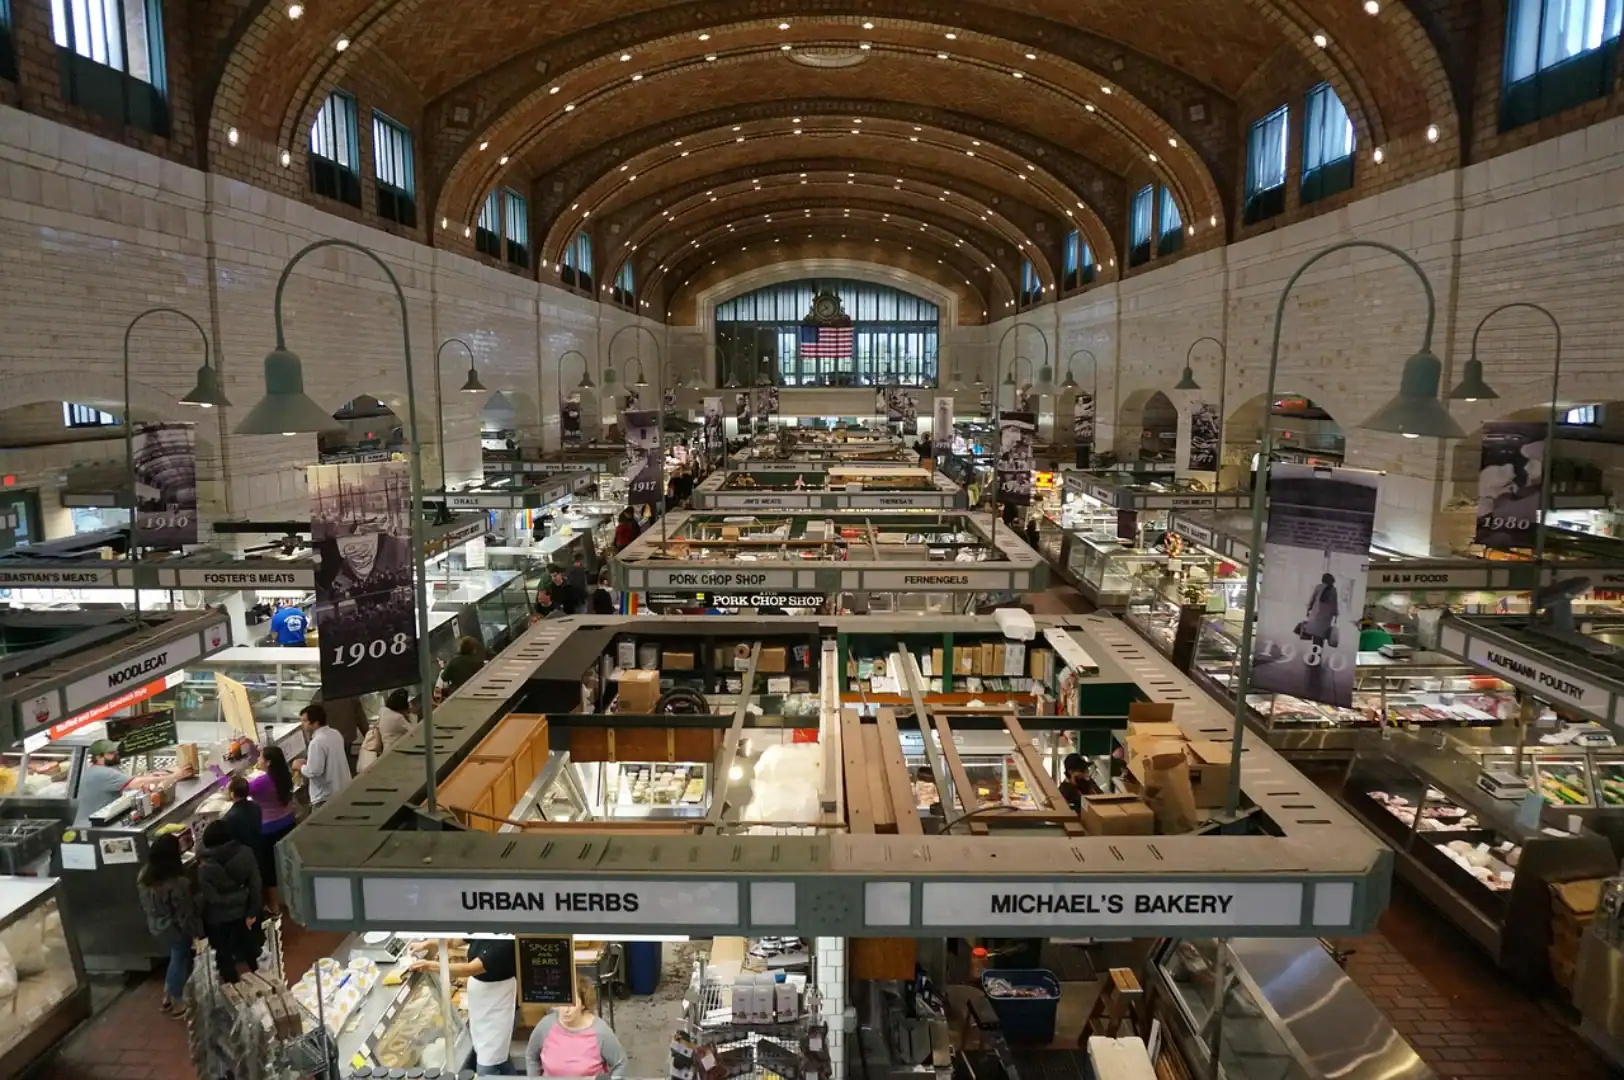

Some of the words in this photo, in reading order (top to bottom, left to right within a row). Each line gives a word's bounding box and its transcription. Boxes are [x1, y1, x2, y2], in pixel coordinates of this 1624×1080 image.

[633, 480, 657, 492] 1917
[146, 516, 189, 531] 1910
[1482, 515, 1530, 530] 1980
[61, 573, 98, 583] MEATS
[204, 573, 257, 583] FOSTER'S
[260, 573, 296, 583] MEATS
[669, 574, 698, 585] PORK
[701, 574, 732, 585] CHOP
[735, 574, 766, 585] SHOP
[904, 575, 969, 584] FERNENGELS
[1382, 574, 1391, 583] M
[1393, 574, 1400, 583] &
[1402, 574, 1411, 583] M
[1414, 574, 1449, 583] FOODS
[712, 595, 749, 606] PORK
[751, 595, 787, 606] CHOP
[788, 595, 824, 606] SHOP
[331, 632, 407, 667] 1908
[1260, 640, 1347, 671] 1980
[108, 652, 168, 688] NOODLECAT
[1487, 650, 1537, 680] KAUFMANN
[1539, 671, 1585, 700] POULTRY
[461, 891, 544, 910] URBAN
[555, 892, 639, 912] HERBS
[990, 894, 1123, 914] MICHAEL'S
[1135, 894, 1233, 914] BAKERY
